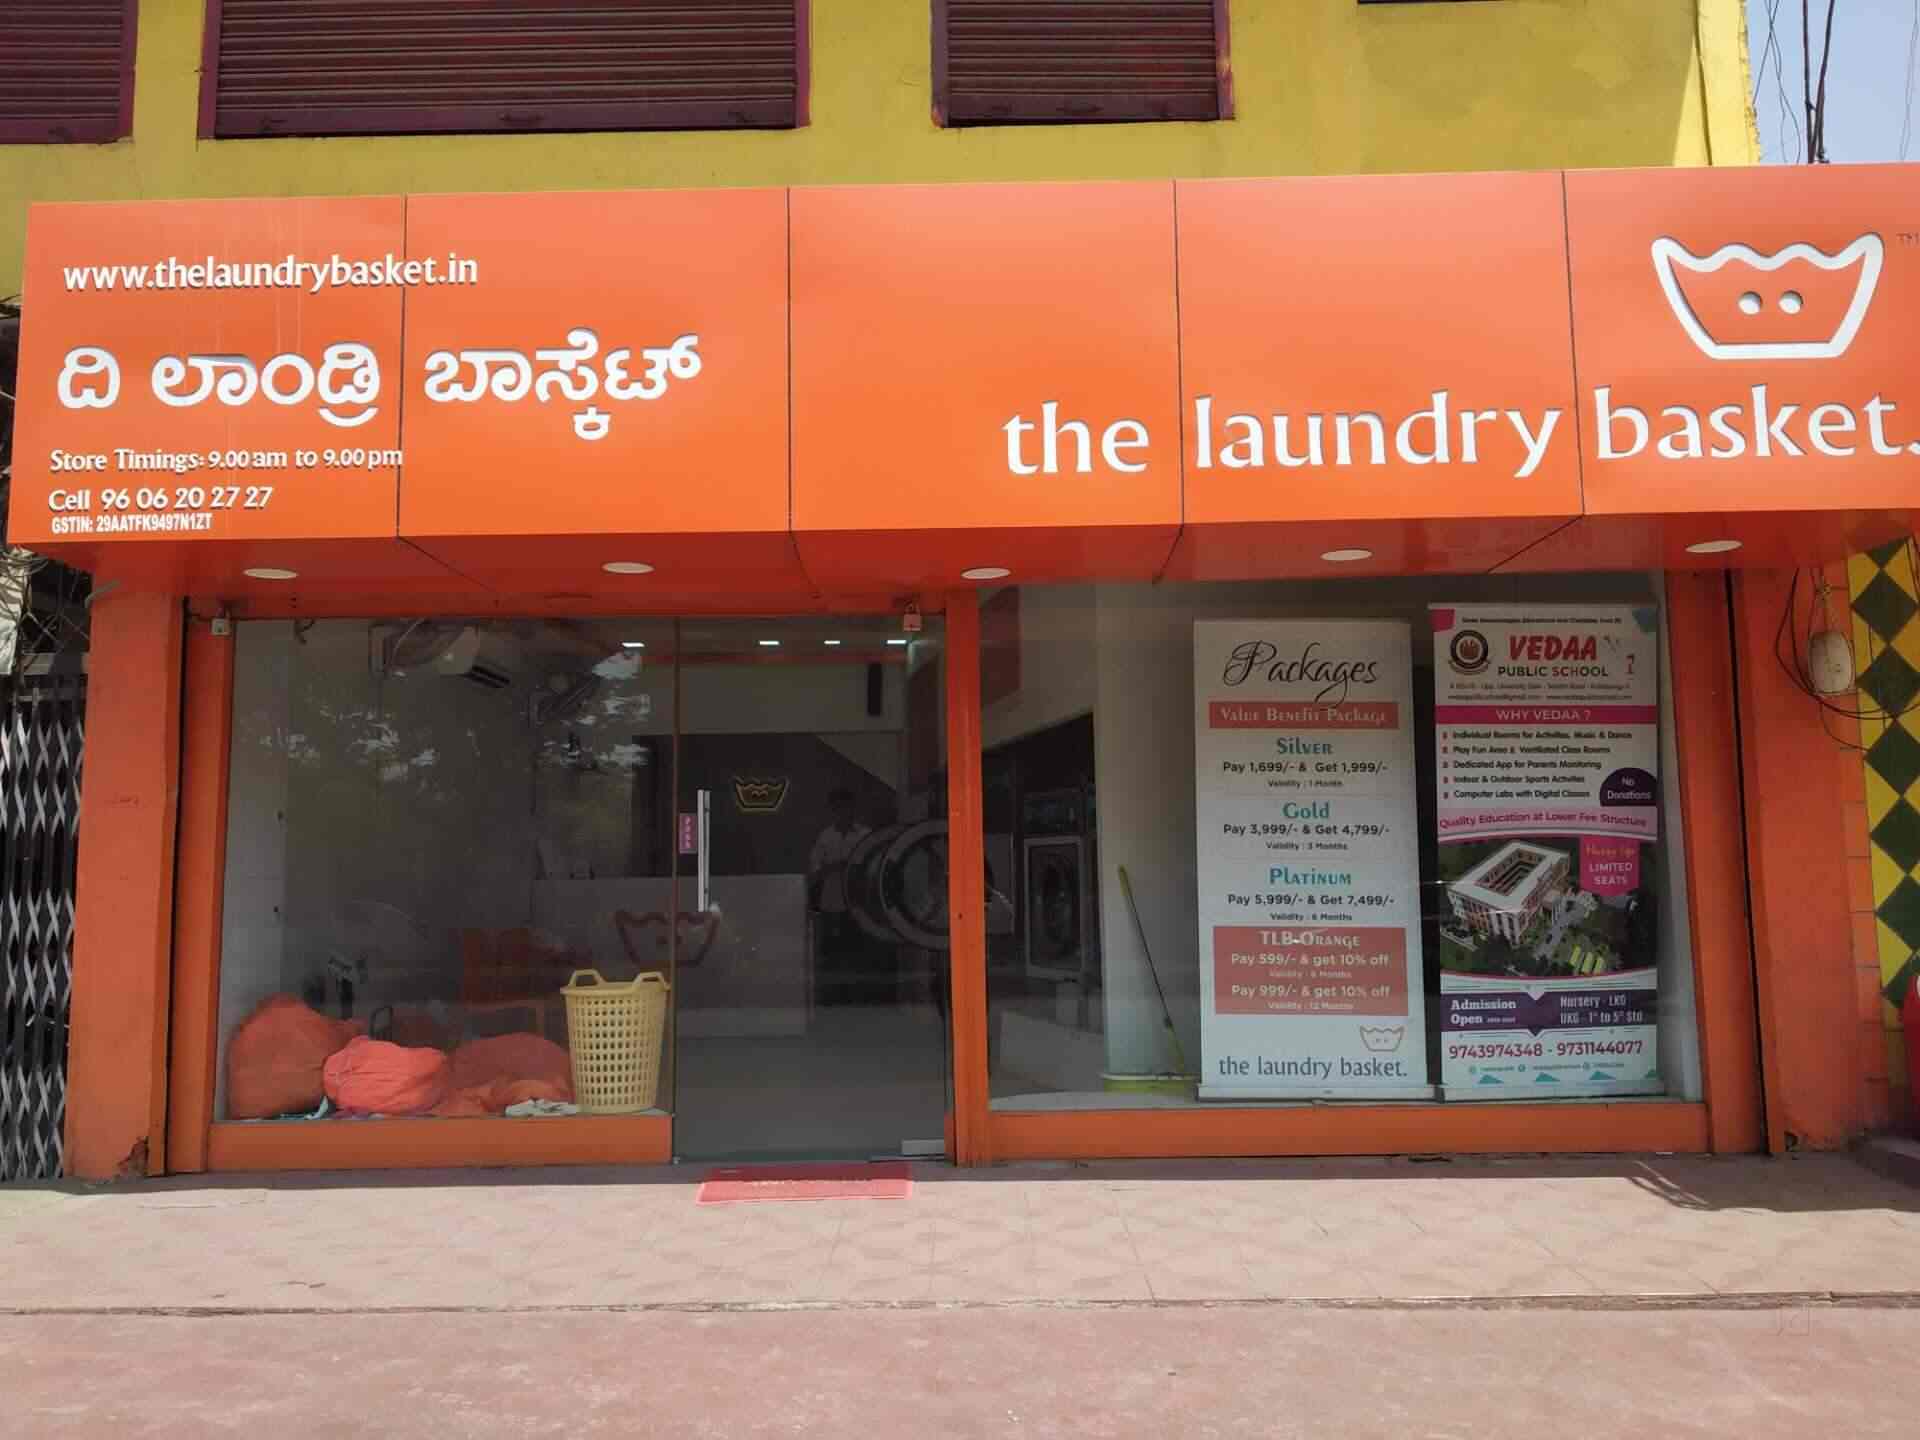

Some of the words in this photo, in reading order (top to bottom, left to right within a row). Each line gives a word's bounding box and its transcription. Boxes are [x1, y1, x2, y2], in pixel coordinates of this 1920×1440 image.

[63, 253, 479, 293] www.thelaundrybasket.in
[56, 344, 121, 409] ದಿ
[150, 340, 382, 427] ಲಾಂಡ್ರಿ
[423, 327, 701, 440] ಬಾಸ್ಕೆಟ್
[1002, 401, 1150, 475] the
[1194, 392, 1564, 478] laundry
[50, 449, 107, 473] Store
[295, 450, 317, 469] to
[48, 489, 90, 511] Cell
[101, 488, 130, 510] 96
[136, 488, 168, 510] 06
[174, 487, 205, 509] 20
[52, 515, 93, 534] GSTIN:
[1507, 635, 1598, 661] VEDAA
[1222, 640, 1379, 712] Packages
[1497, 666, 1548, 677] PUBLIC
[1552, 666, 1608, 677] SCHOOL
[1496, 710, 1528, 721] WHY
[1533, 710, 1579, 721] VEDAA
[1453, 731, 1491, 739] Individual
[1223, 762, 1245, 776] Pay
[1315, 761, 1337, 774] Get
[1341, 761, 1388, 774] 1,999/-
[1453, 760, 1494, 769] Dedicated
[1496, 760, 1512, 771] App
[1527, 760, 1557, 769] Parents
[1453, 775, 1479, 784] Indoor
[1491, 775, 1523, 784] Outdoor
[1525, 775, 1549, 785] Sports
[1453, 790, 1493, 800] Computer
[1495, 790, 1513, 798] Labs
[1516, 790, 1532, 798] with
[1534, 790, 1560, 800] Digital
[1283, 801, 1330, 819] Gold
[1440, 815, 1476, 829] Quality
[1479, 811, 1529, 823] Education
[1548, 810, 1576, 821] Lower
[1579, 810, 1596, 821] Fee
[1600, 811, 1647, 827] Structure
[1223, 824, 1245, 839] Pay
[1249, 824, 1298, 837] 3,999/-
[1315, 824, 1337, 837] Get
[1342, 824, 1389, 837] 4,799/-
[1589, 862, 1632, 873] LIMITED
[1228, 894, 1250, 908] Pay
[1255, 893, 1303, 906] 5,999/-
[1320, 893, 1342, 906] Get
[1347, 893, 1394, 906] 7,499/-
[1270, 912, 1304, 922] Validity
[1231, 953, 1253, 967] Pay
[1259, 953, 1296, 965] 599/-
[1312, 954, 1335, 968] get
[1341, 953, 1365, 965] 10%
[1370, 953, 1389, 965] off
[1231, 985, 1255, 998] Pay
[1259, 985, 1296, 997] 999/-
[1314, 986, 1336, 1000] get
[1341, 985, 1366, 997] 10%
[1371, 985, 1390, 997] off
[1451, 999, 1516, 1010] Admission
[1451, 1013, 1483, 1026] Open
[1449, 1042, 1543, 1059] 9743974348
[1557, 1040, 1643, 1056] 9731144077
[1219, 1056, 1250, 1076] the
[1258, 1056, 1333, 1080] laundry
[1341, 1057, 1407, 1077] basket.
